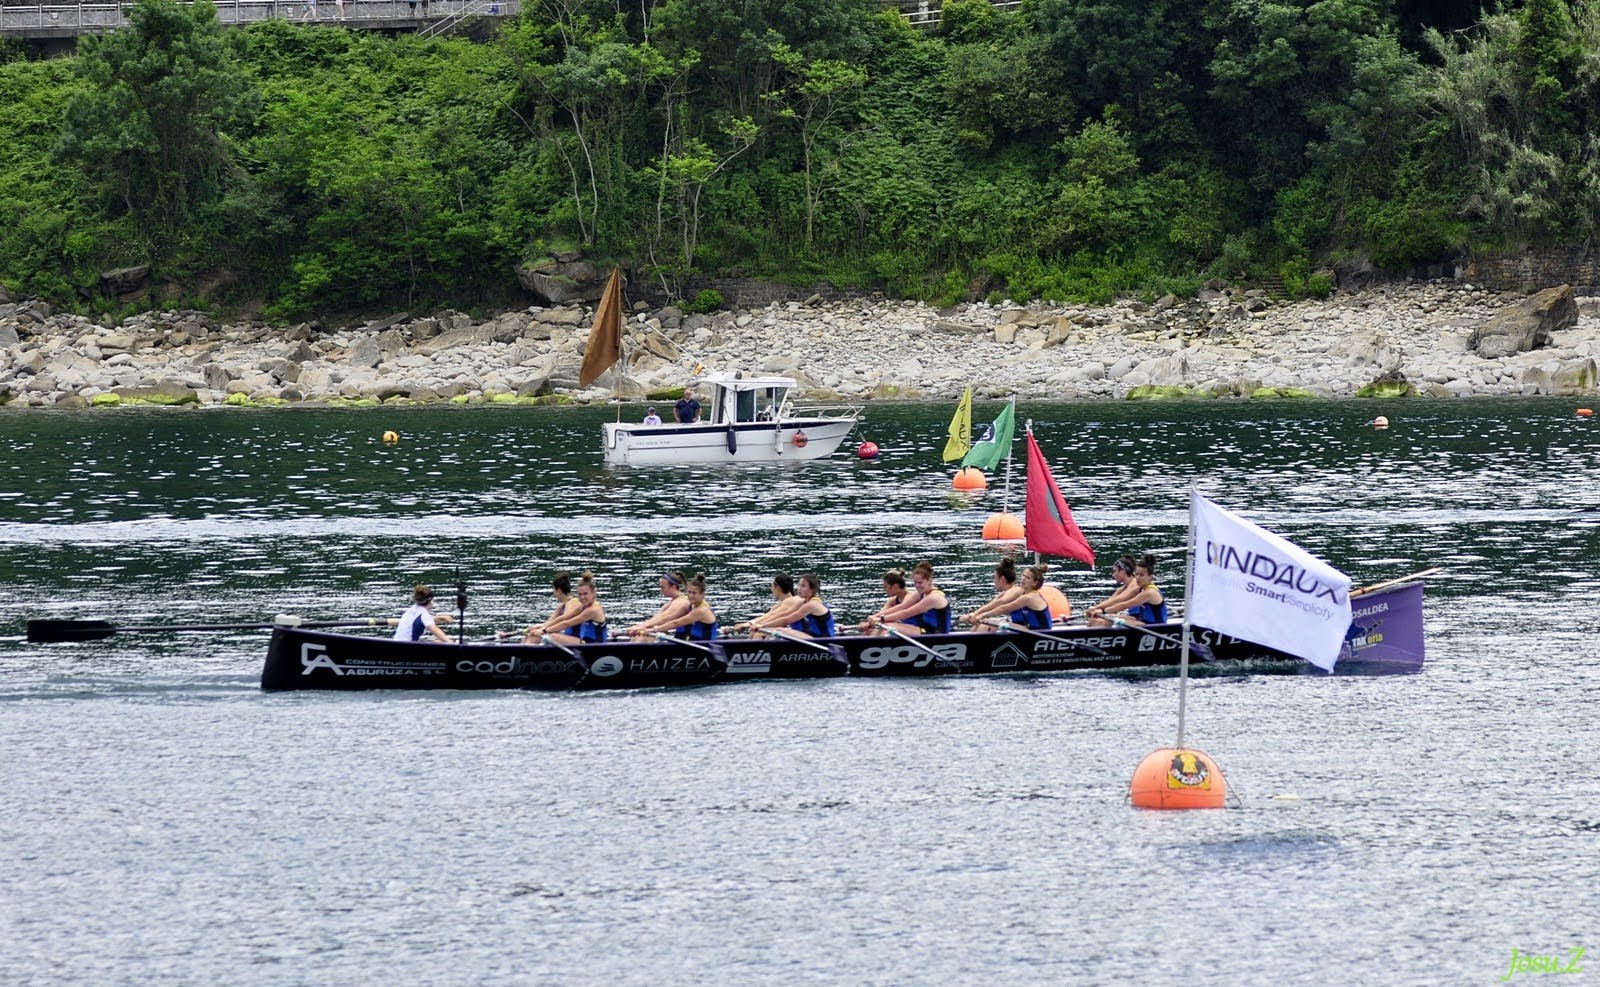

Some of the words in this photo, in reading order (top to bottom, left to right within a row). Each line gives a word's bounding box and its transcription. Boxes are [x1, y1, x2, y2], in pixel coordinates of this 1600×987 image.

[1246, 582, 1285, 603] Smart
[345, 658, 447, 667] CONSTRUCCIONES
[456, 656, 579, 673] cadinox
[728, 650, 772, 666] AVIA
[859, 643, 968, 669] goya
